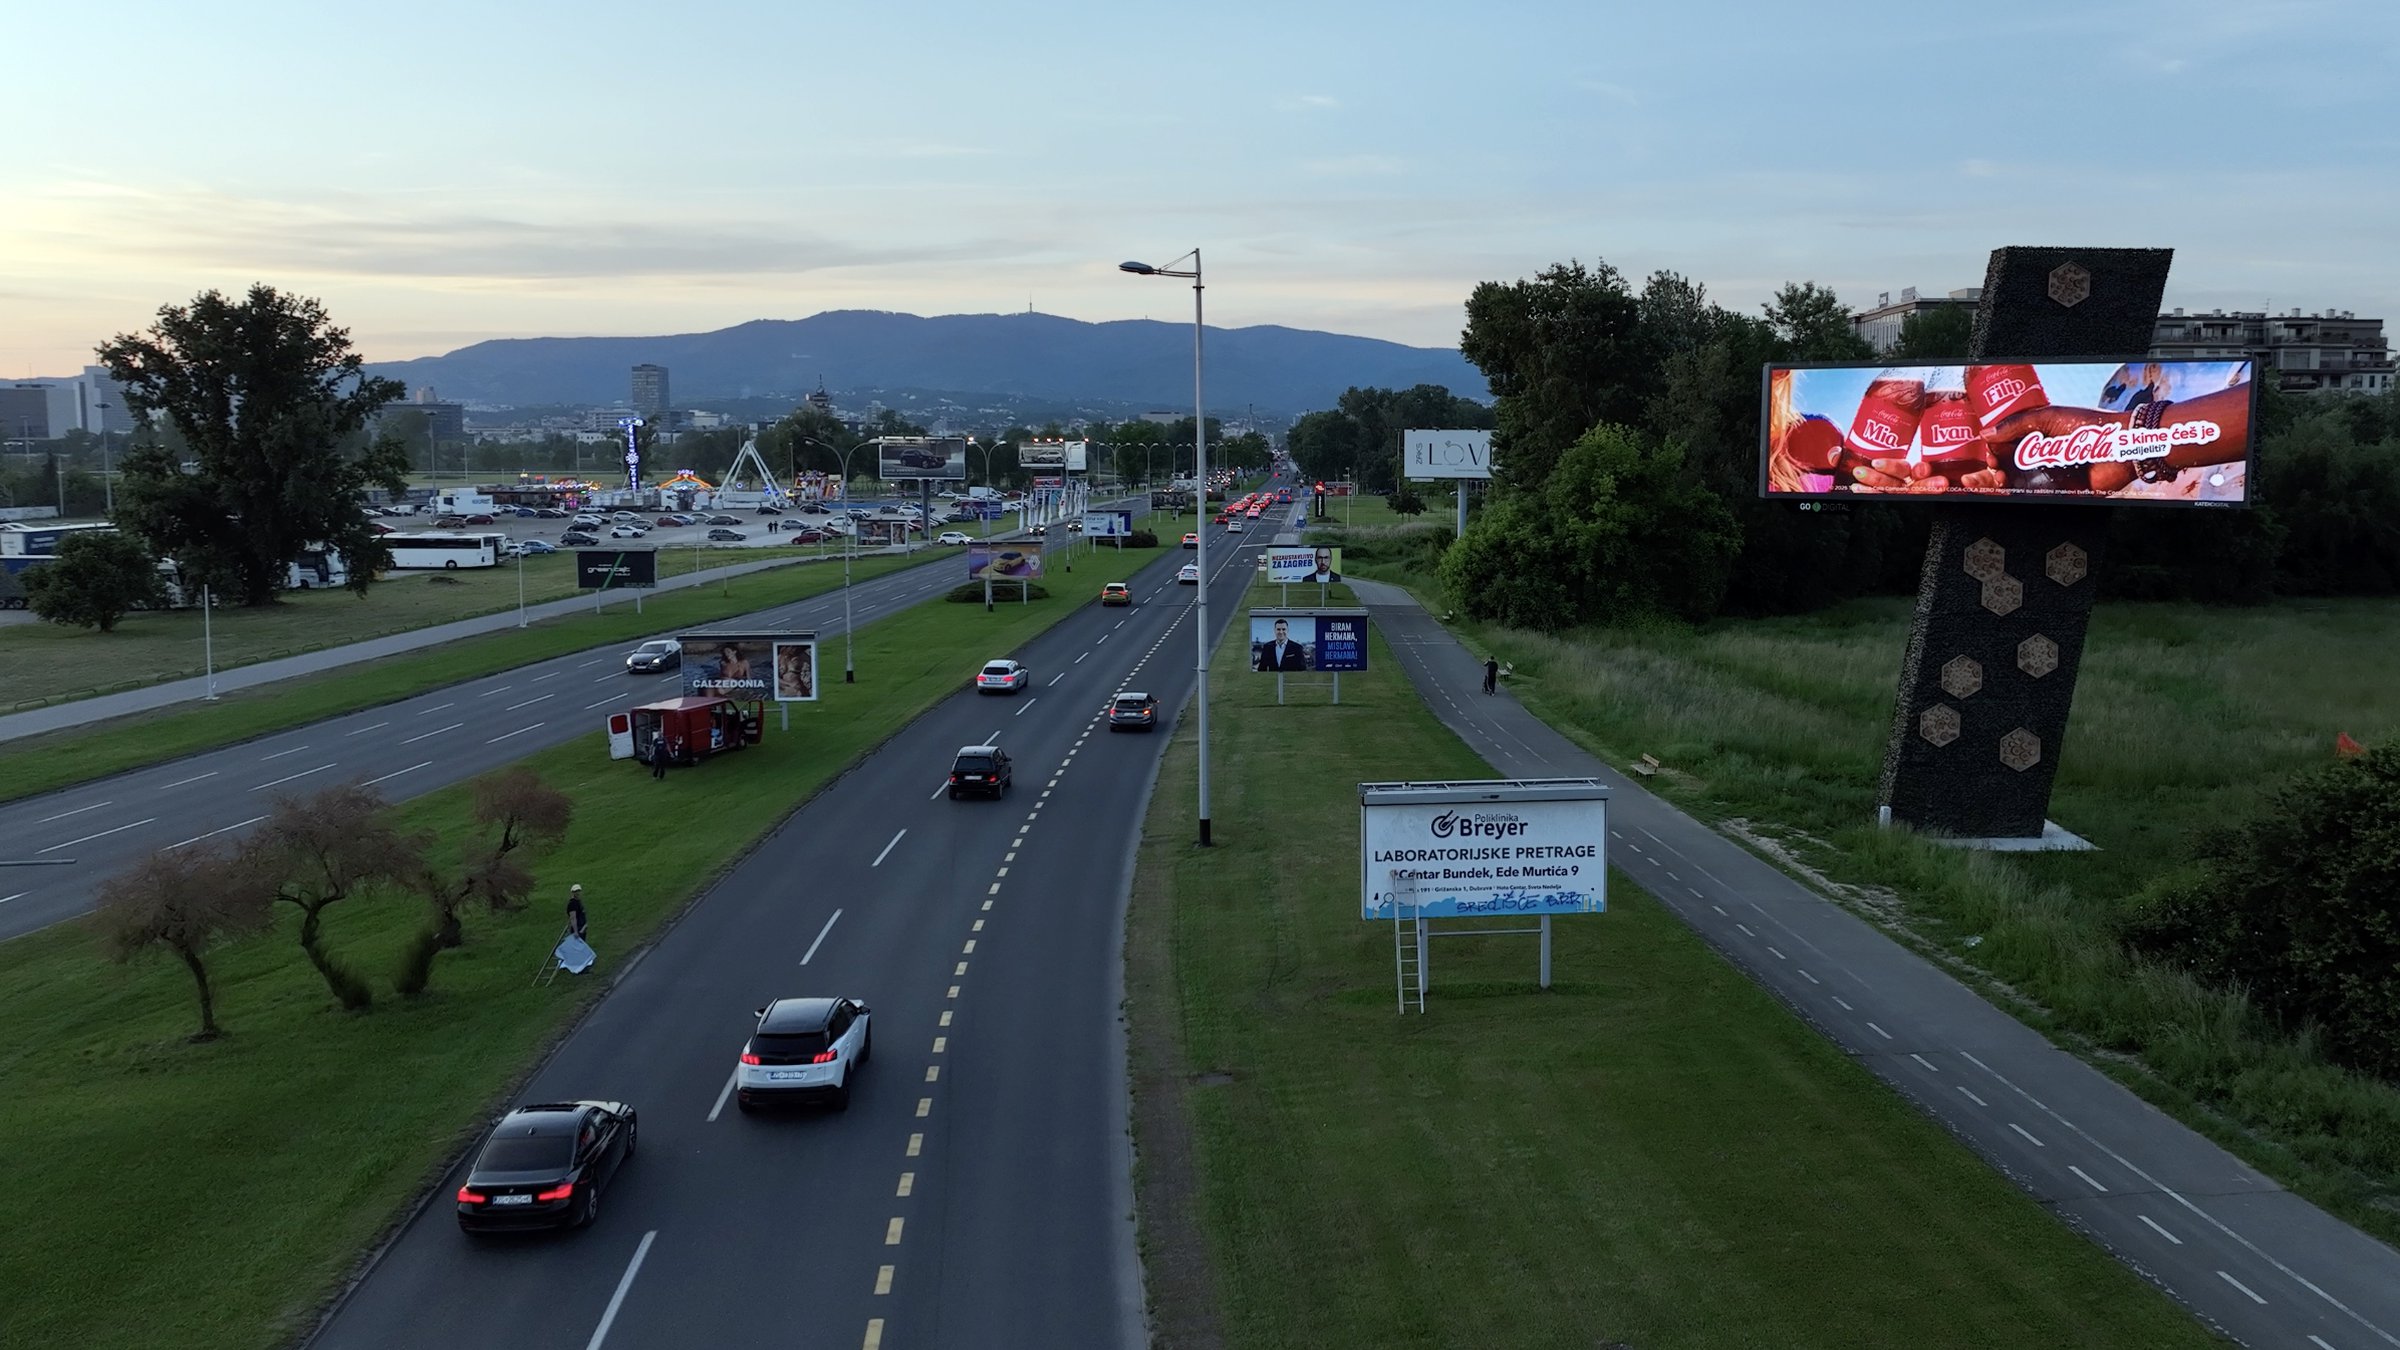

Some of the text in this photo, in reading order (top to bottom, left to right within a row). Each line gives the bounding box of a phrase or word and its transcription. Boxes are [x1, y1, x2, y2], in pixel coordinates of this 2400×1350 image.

[1982, 378, 2026, 407] Filip
[1862, 420, 1898, 448] Mia
[1931, 424, 1973, 444] Ivan
[2119, 426, 2215, 446] S kime ćeš je
[2018, 426, 2118, 466] Coca-Cola
[2120, 444, 2166, 457] podijeliti?
[1283, 559, 1313, 568] ZAGREB
[1331, 622, 1351, 631] BIRAM
[1325, 632, 1358, 642] HERMANA,
[1328, 642, 1355, 650] MISLAVA
[1325, 651, 1358, 660] HERMANA!
[692, 679, 765, 688] CALZEDONIA
[1474, 814, 1518, 822] Poliklinika
[1460, 819, 1528, 840] Breyer
[1374, 845, 1596, 862] LABORATORIJSKE PRETRAGE
[1443, 867, 1493, 879] Bundek,
[1496, 866, 1519, 877] Ede
[1522, 865, 1568, 876] Murtića
[1572, 865, 1579, 876] 9
